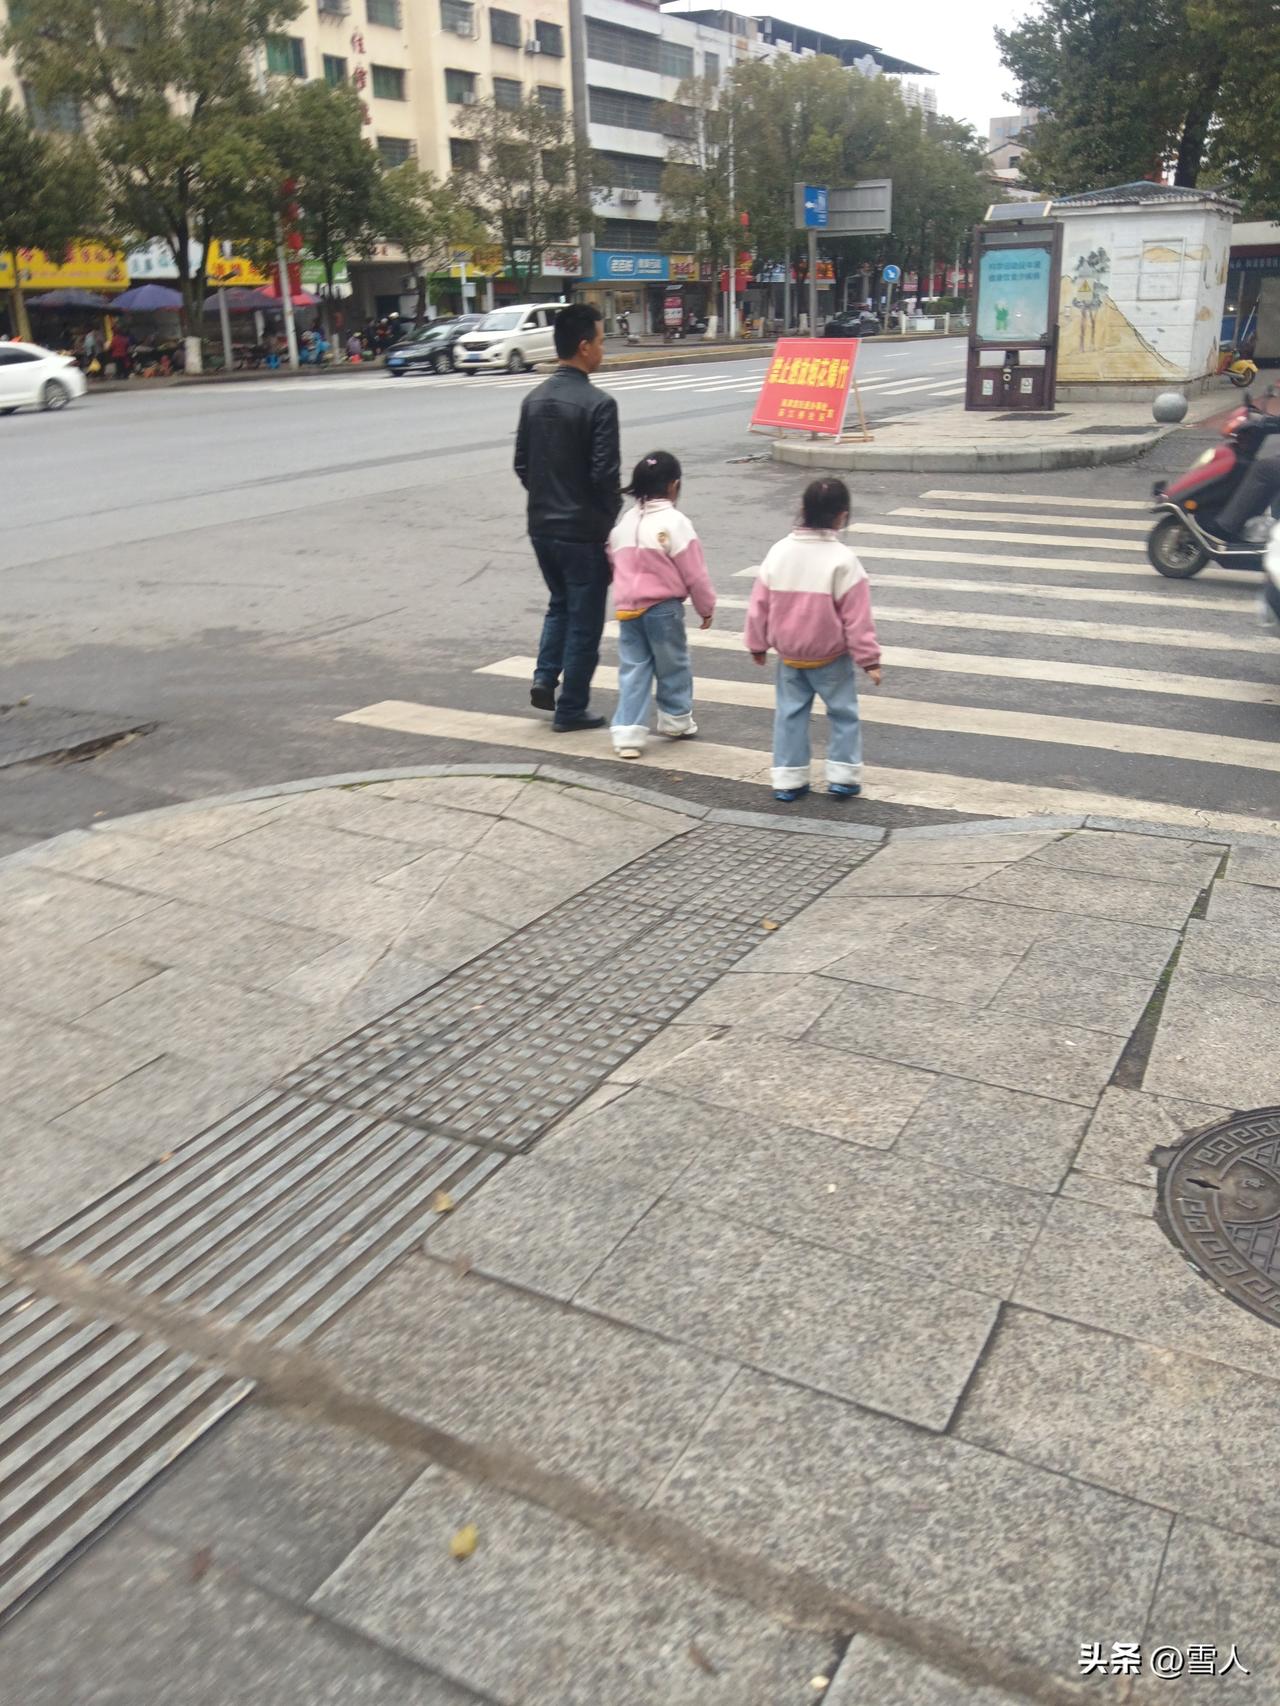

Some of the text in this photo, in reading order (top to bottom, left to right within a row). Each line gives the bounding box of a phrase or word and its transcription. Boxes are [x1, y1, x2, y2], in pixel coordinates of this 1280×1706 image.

[768, 356, 850, 389] 禁止燃放烟花爆竹
